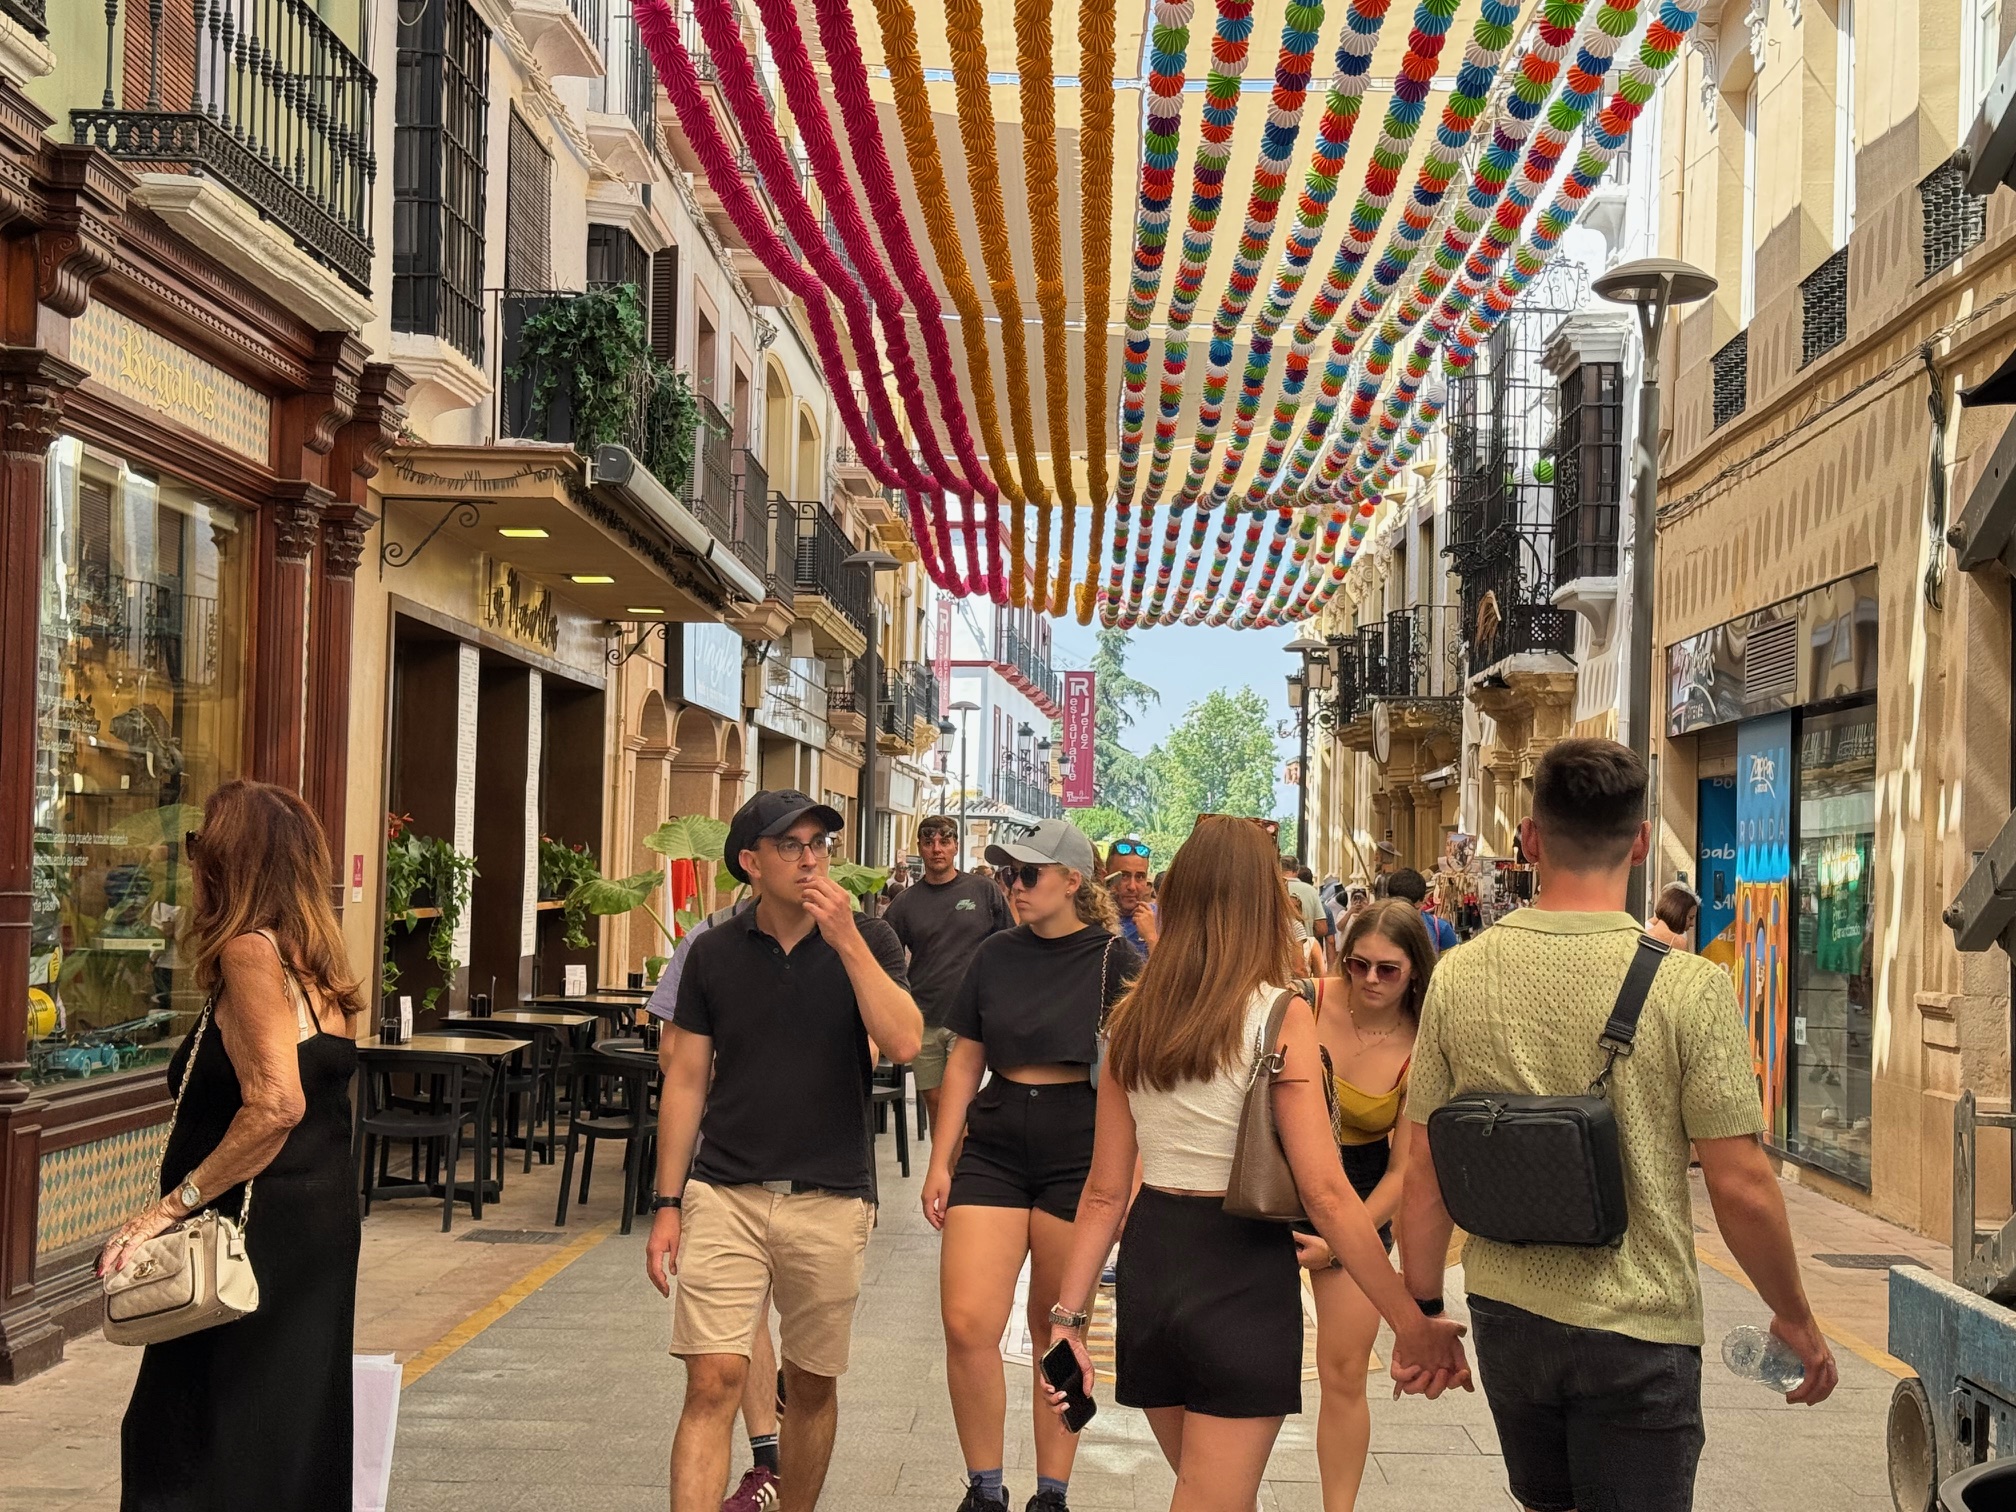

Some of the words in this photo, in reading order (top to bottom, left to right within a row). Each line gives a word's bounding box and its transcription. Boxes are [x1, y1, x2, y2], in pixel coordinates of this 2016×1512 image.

[120, 324, 215, 422] Regalos
[1080, 697, 1090, 750] Jerez
[1740, 817, 1785, 842] RONDA
